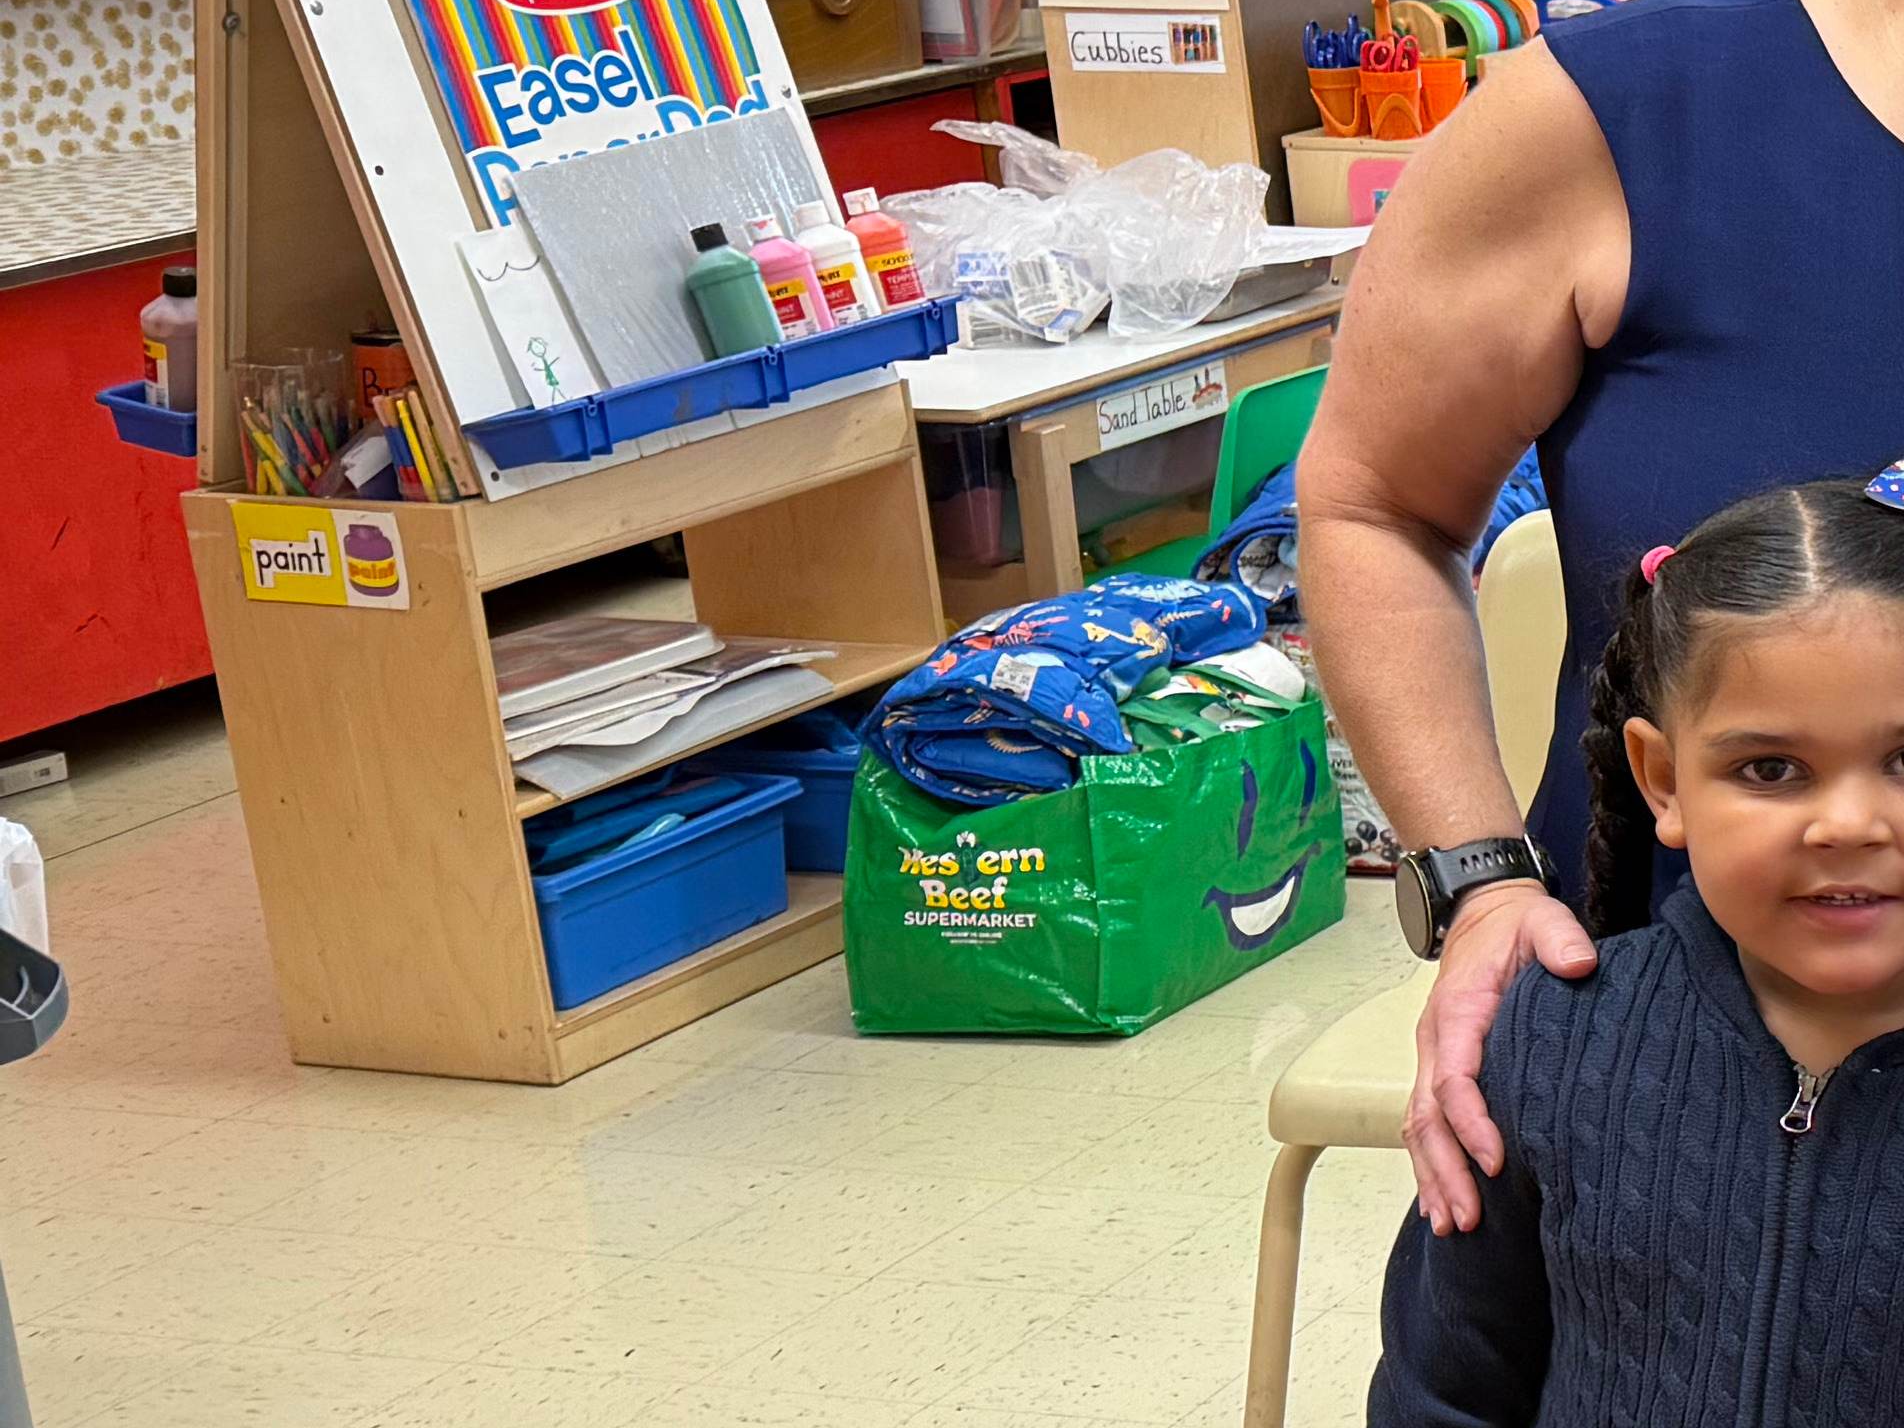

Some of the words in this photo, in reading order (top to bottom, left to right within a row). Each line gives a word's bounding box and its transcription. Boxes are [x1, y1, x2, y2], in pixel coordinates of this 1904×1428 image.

[1070, 31, 1164, 64] Cubbies
[478, 30, 655, 149] Easel
[1100, 393, 1138, 434] Sand
[1139, 381, 1186, 422] Table
[255, 538, 325, 586] paint
[919, 875, 1009, 910] Beef
[903, 910, 1037, 928] SUPERMARKET
